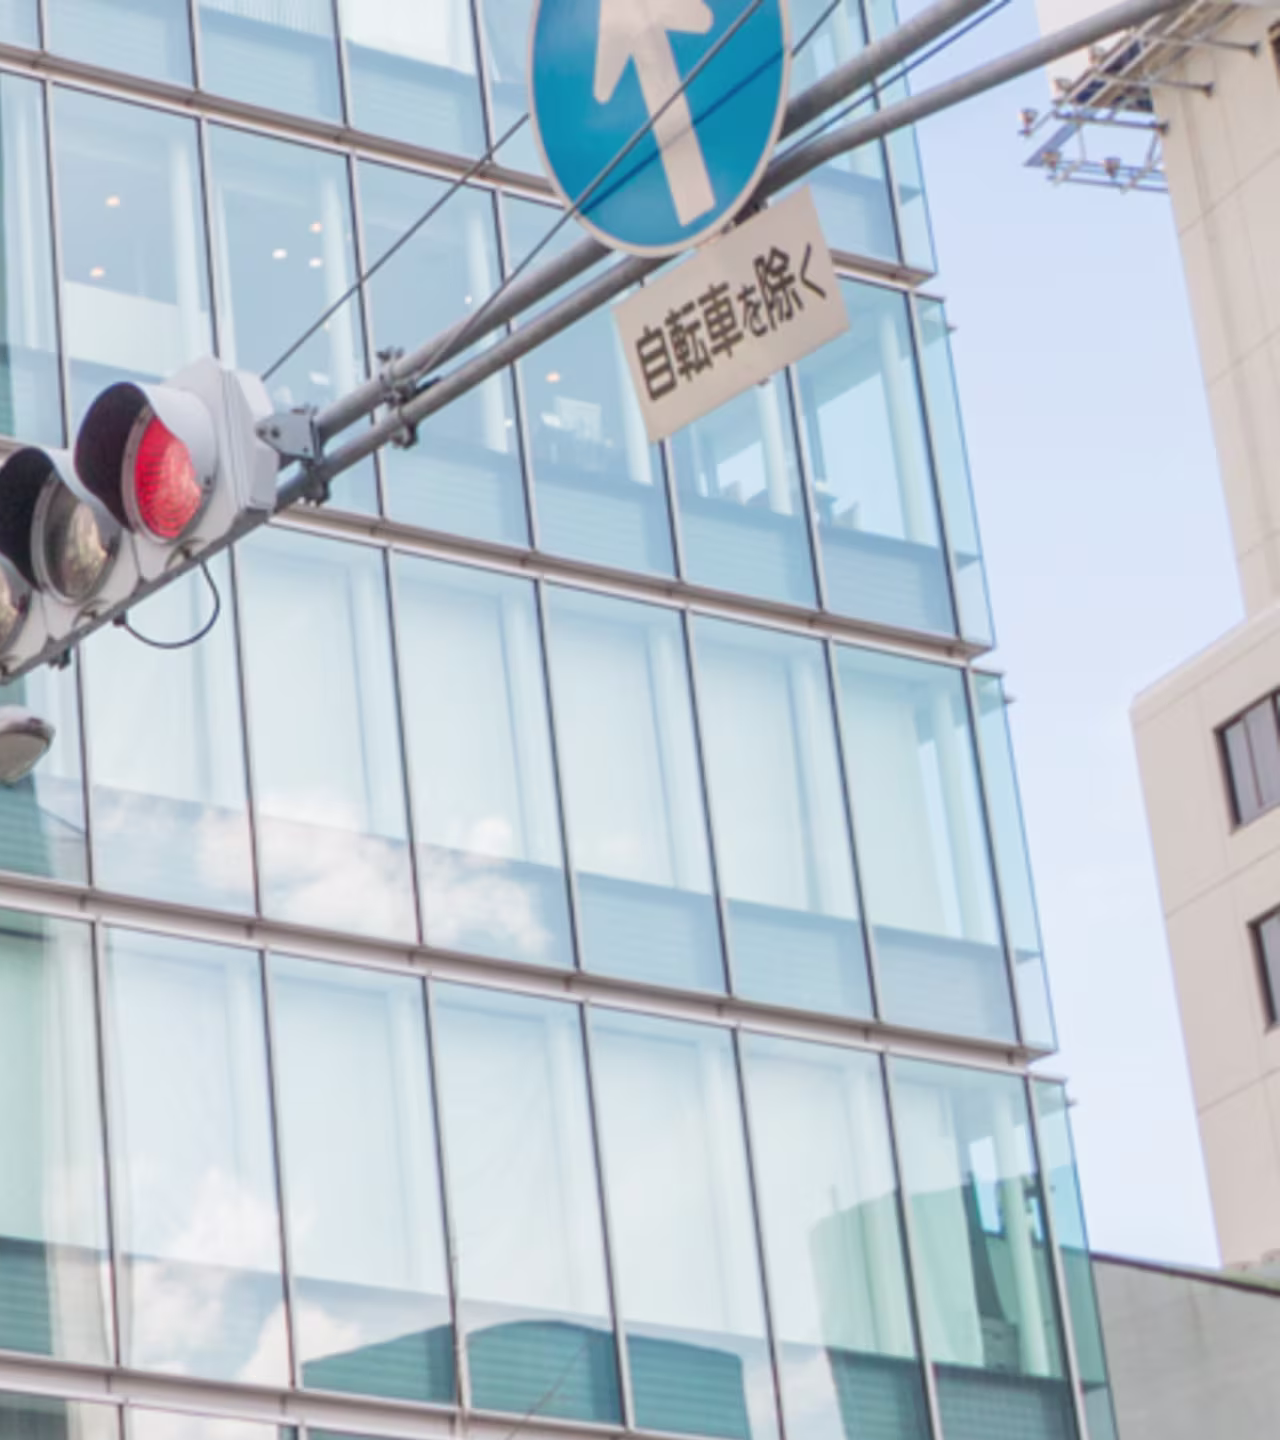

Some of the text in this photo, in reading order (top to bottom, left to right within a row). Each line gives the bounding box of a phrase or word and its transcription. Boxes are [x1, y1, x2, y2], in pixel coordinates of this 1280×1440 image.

[636, 242, 826, 401] 自転車を除く
